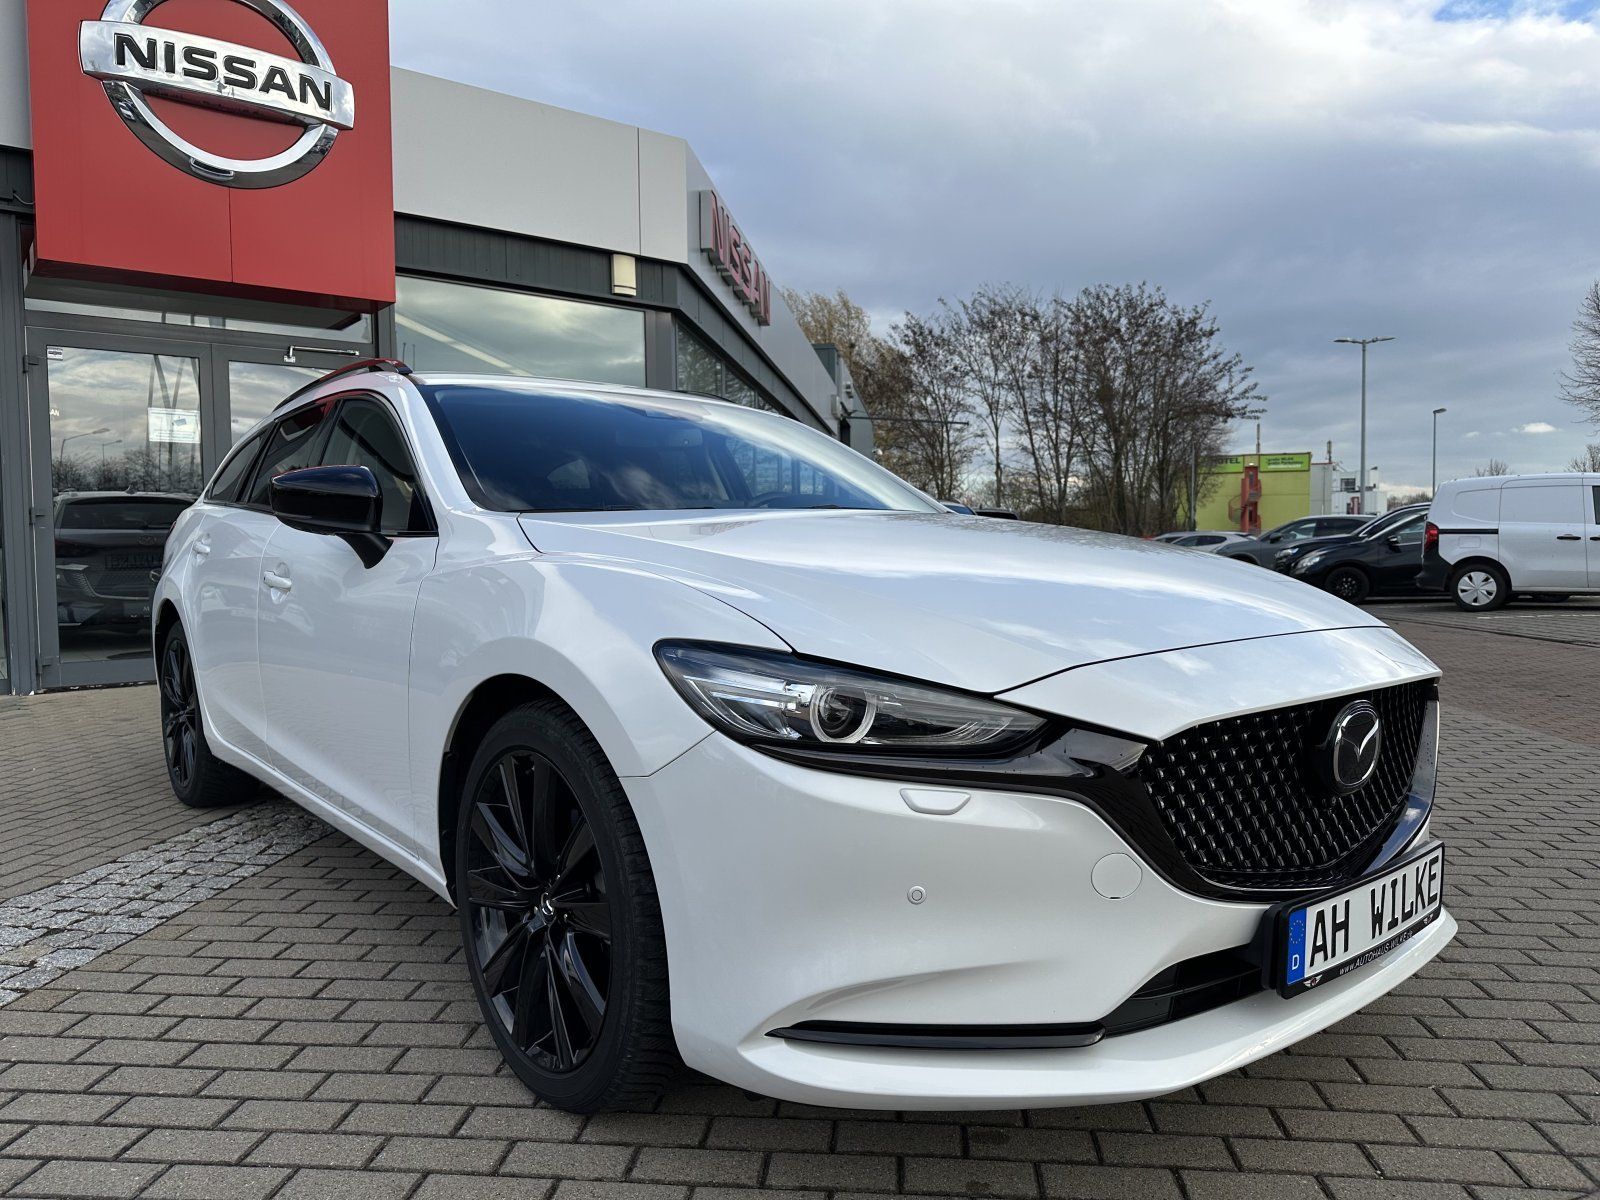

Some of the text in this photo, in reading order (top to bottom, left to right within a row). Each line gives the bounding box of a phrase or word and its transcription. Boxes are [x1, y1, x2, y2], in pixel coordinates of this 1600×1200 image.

[114, 33, 332, 111] NISSAN
[700, 190, 772, 326] NISSAN
[1309, 854, 1439, 967] AH WILKE
[1291, 954, 1300, 971] D
